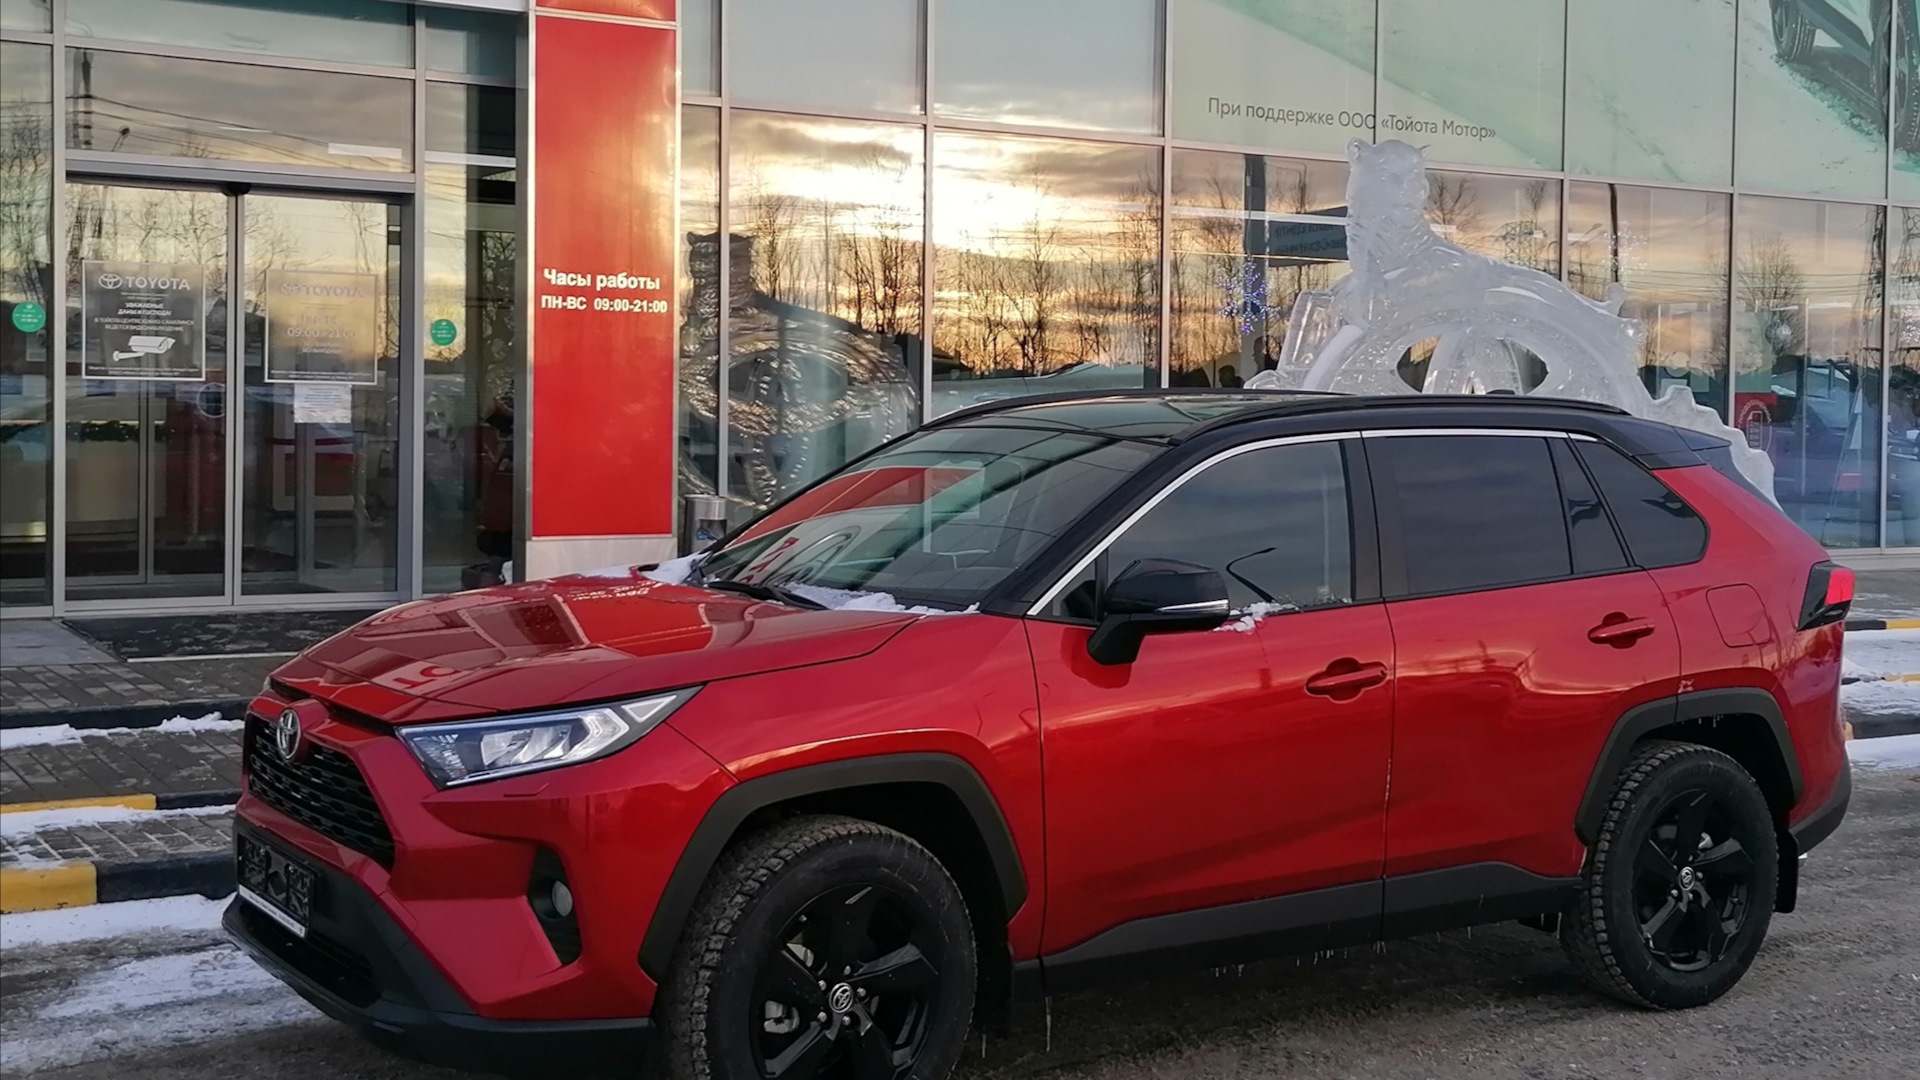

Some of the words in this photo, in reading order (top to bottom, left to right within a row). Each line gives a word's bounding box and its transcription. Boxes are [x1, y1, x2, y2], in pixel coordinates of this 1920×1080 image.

[1208, 97, 1241, 119] При
[1246, 102, 1334, 126] поддержке
[1338, 111, 1376, 130] ООО
[1381, 114, 1438, 135] «Тойота
[1442, 120, 1497, 140] Мотор»
[125, 276, 191, 291] TOYOTA
[543, 268, 591, 286] Часы
[595, 272, 661, 291] работы
[302, 284, 365, 298] TOYOTA
[541, 295, 588, 310] ПН-ВС
[593, 298, 669, 313] 09:00-21:00
